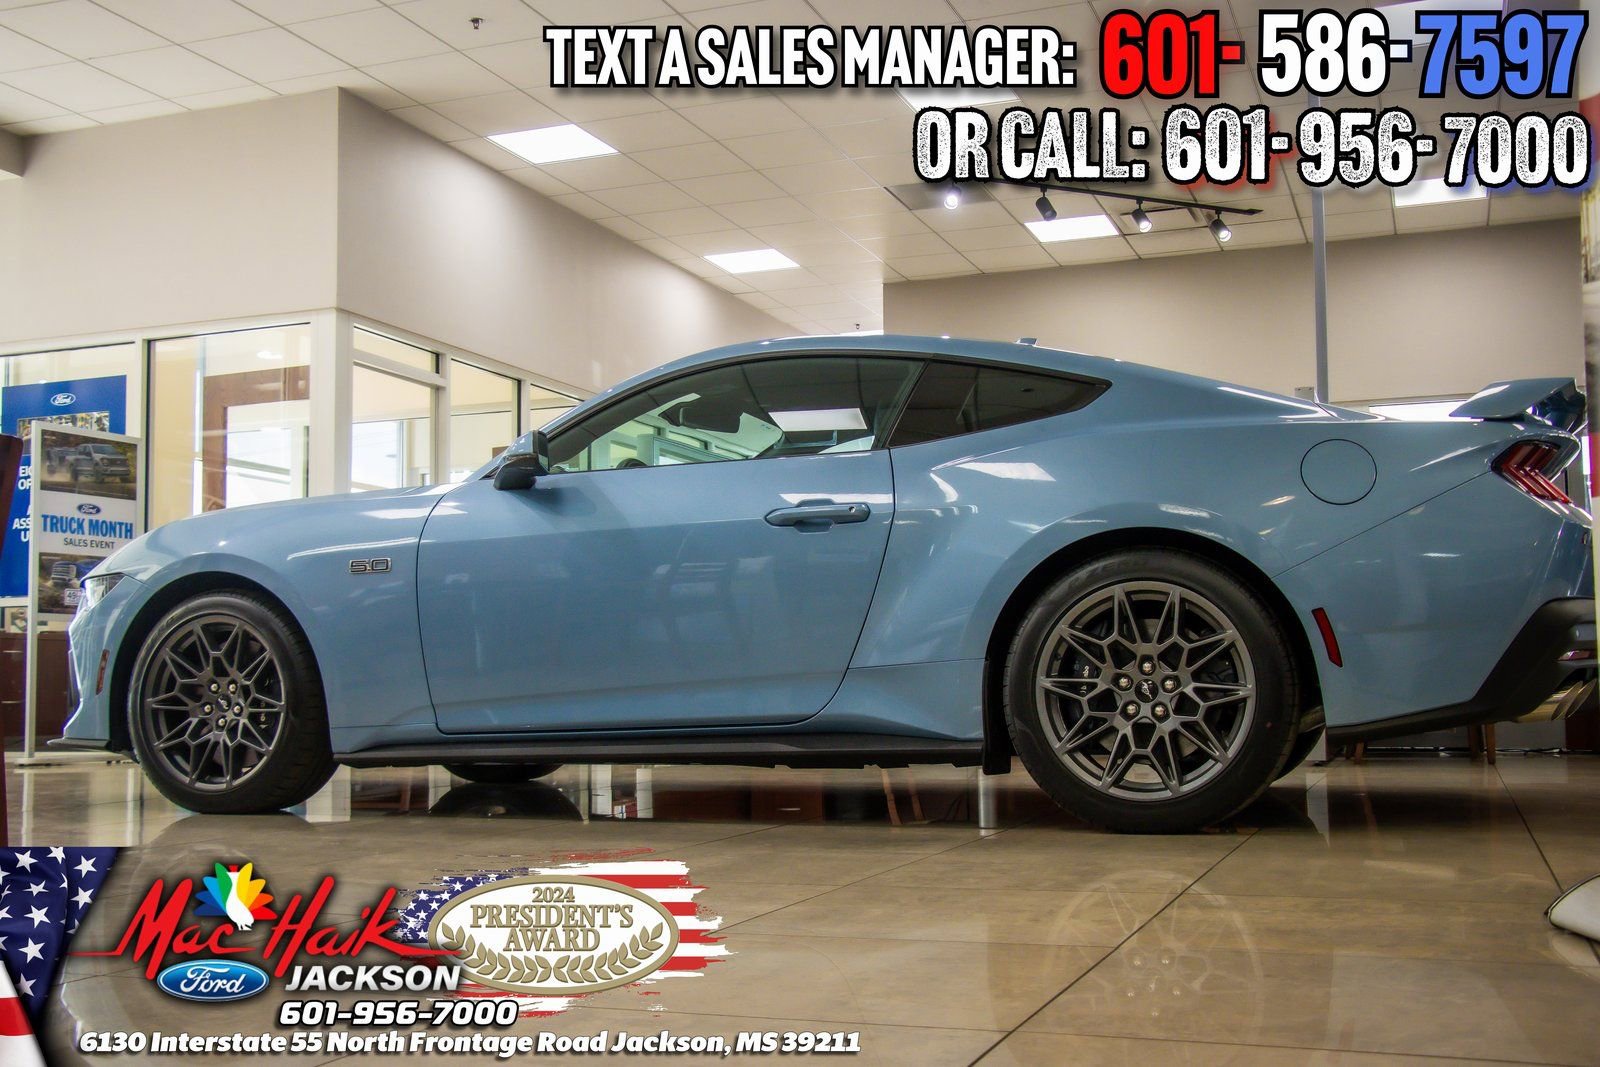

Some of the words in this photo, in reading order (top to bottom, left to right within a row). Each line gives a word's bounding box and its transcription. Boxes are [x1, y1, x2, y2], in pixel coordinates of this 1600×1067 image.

[53, 393, 74, 405] Ford
[79, 503, 99, 514] Ford
[41, 514, 85, 535] TRUCK
[88, 518, 133, 539] MONTH
[63, 537, 88, 548] SALES
[90, 539, 115, 549] EVENT
[349, 557, 391, 574] 5.0
